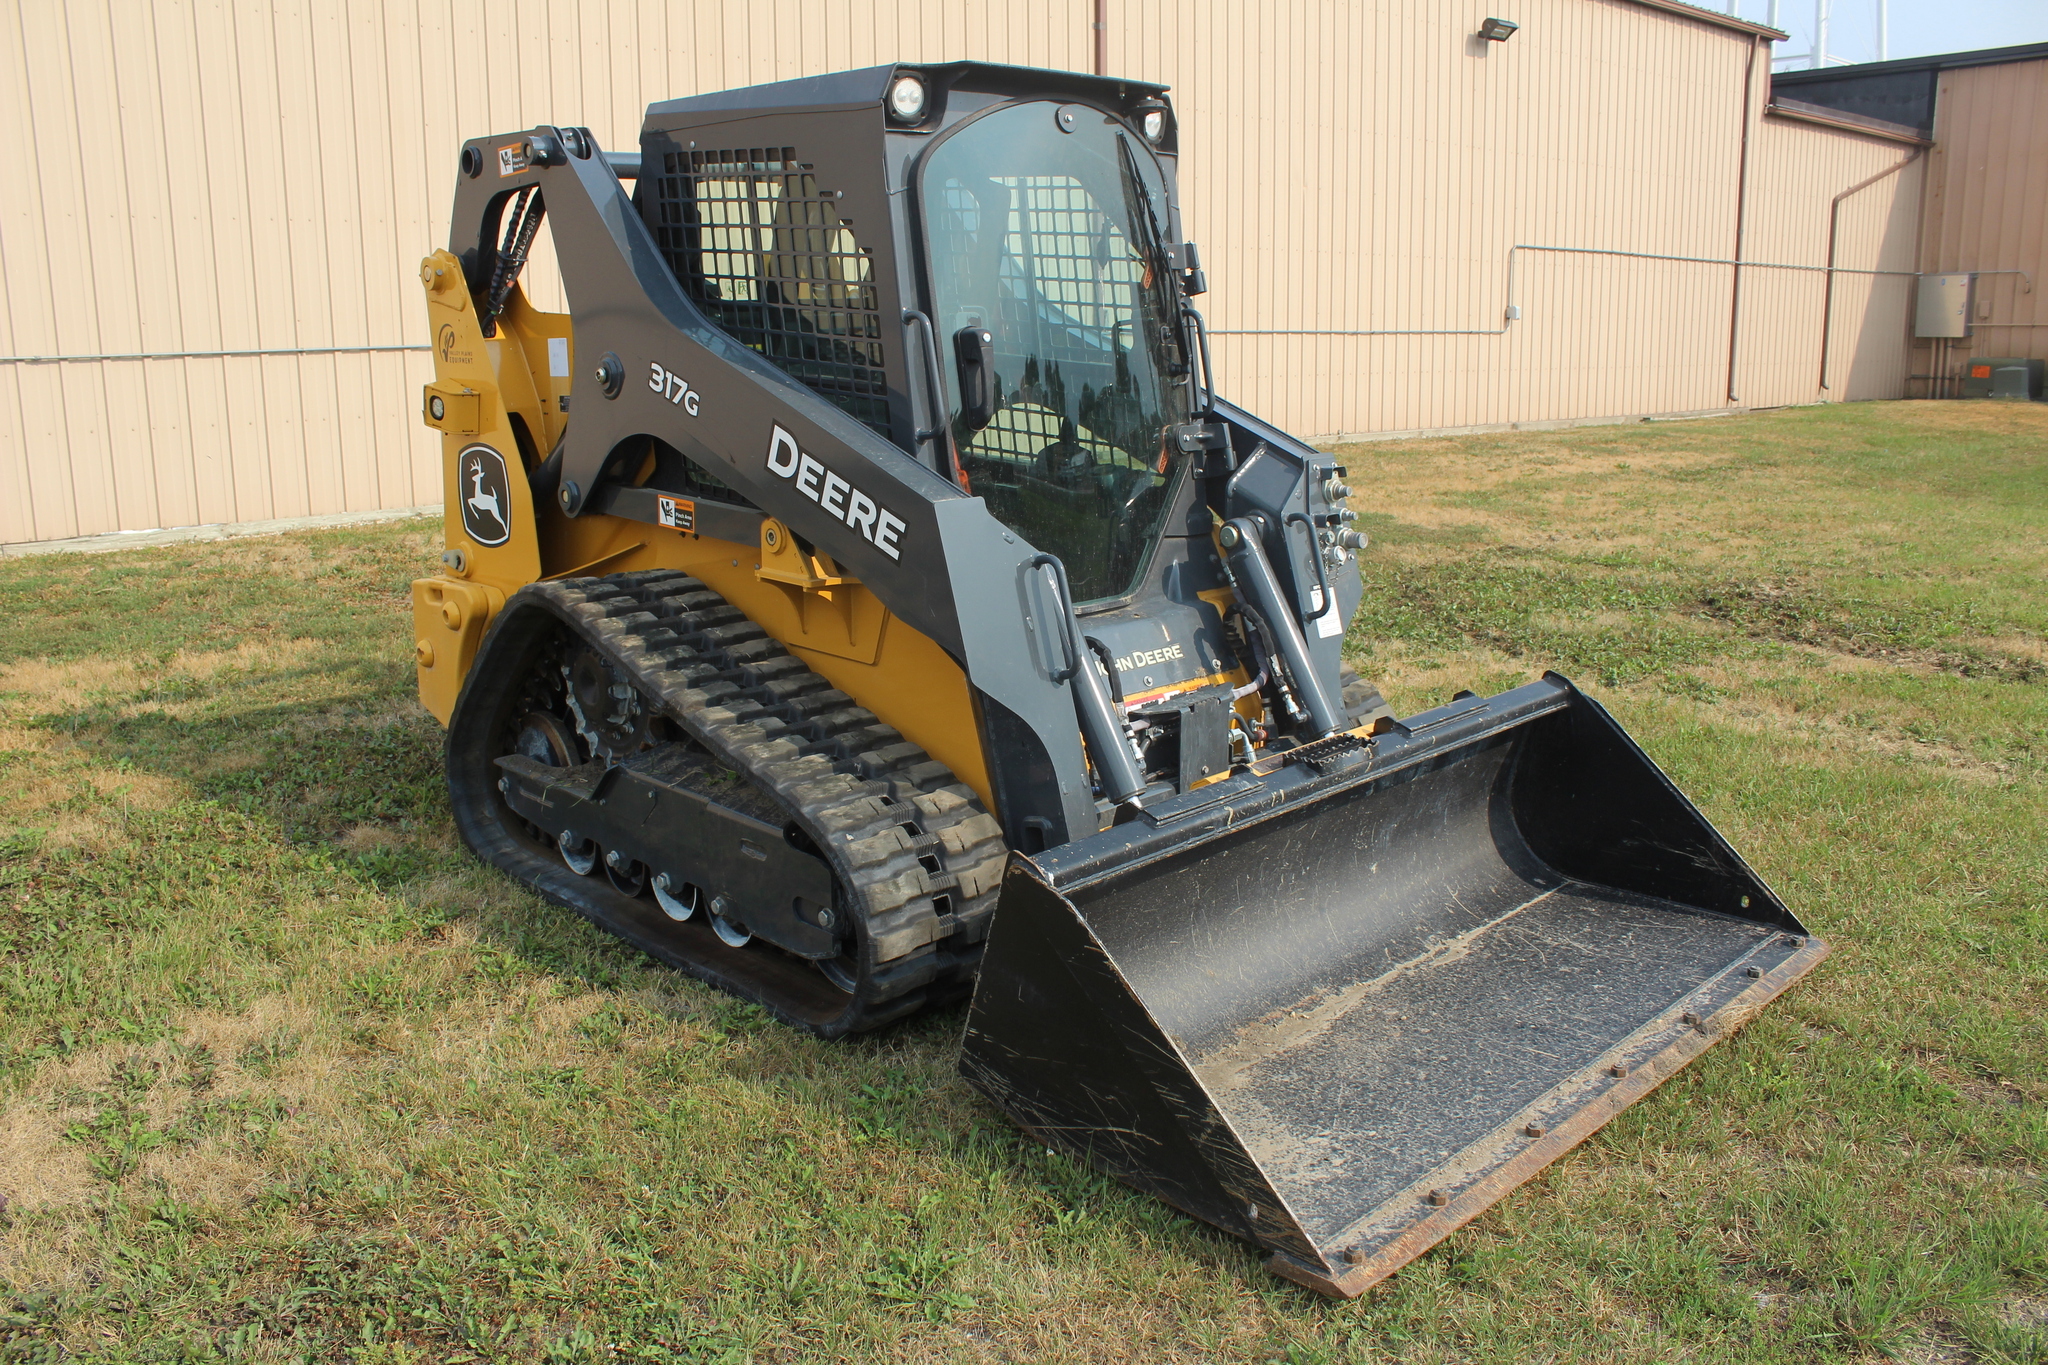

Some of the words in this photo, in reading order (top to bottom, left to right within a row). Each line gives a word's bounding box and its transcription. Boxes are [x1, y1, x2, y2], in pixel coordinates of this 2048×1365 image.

[449, 356, 473, 364] EQUIPMENT
[648, 362, 700, 418] 317G
[766, 424, 906, 561] DEERE
[1132, 644, 1184, 669] DEERE
